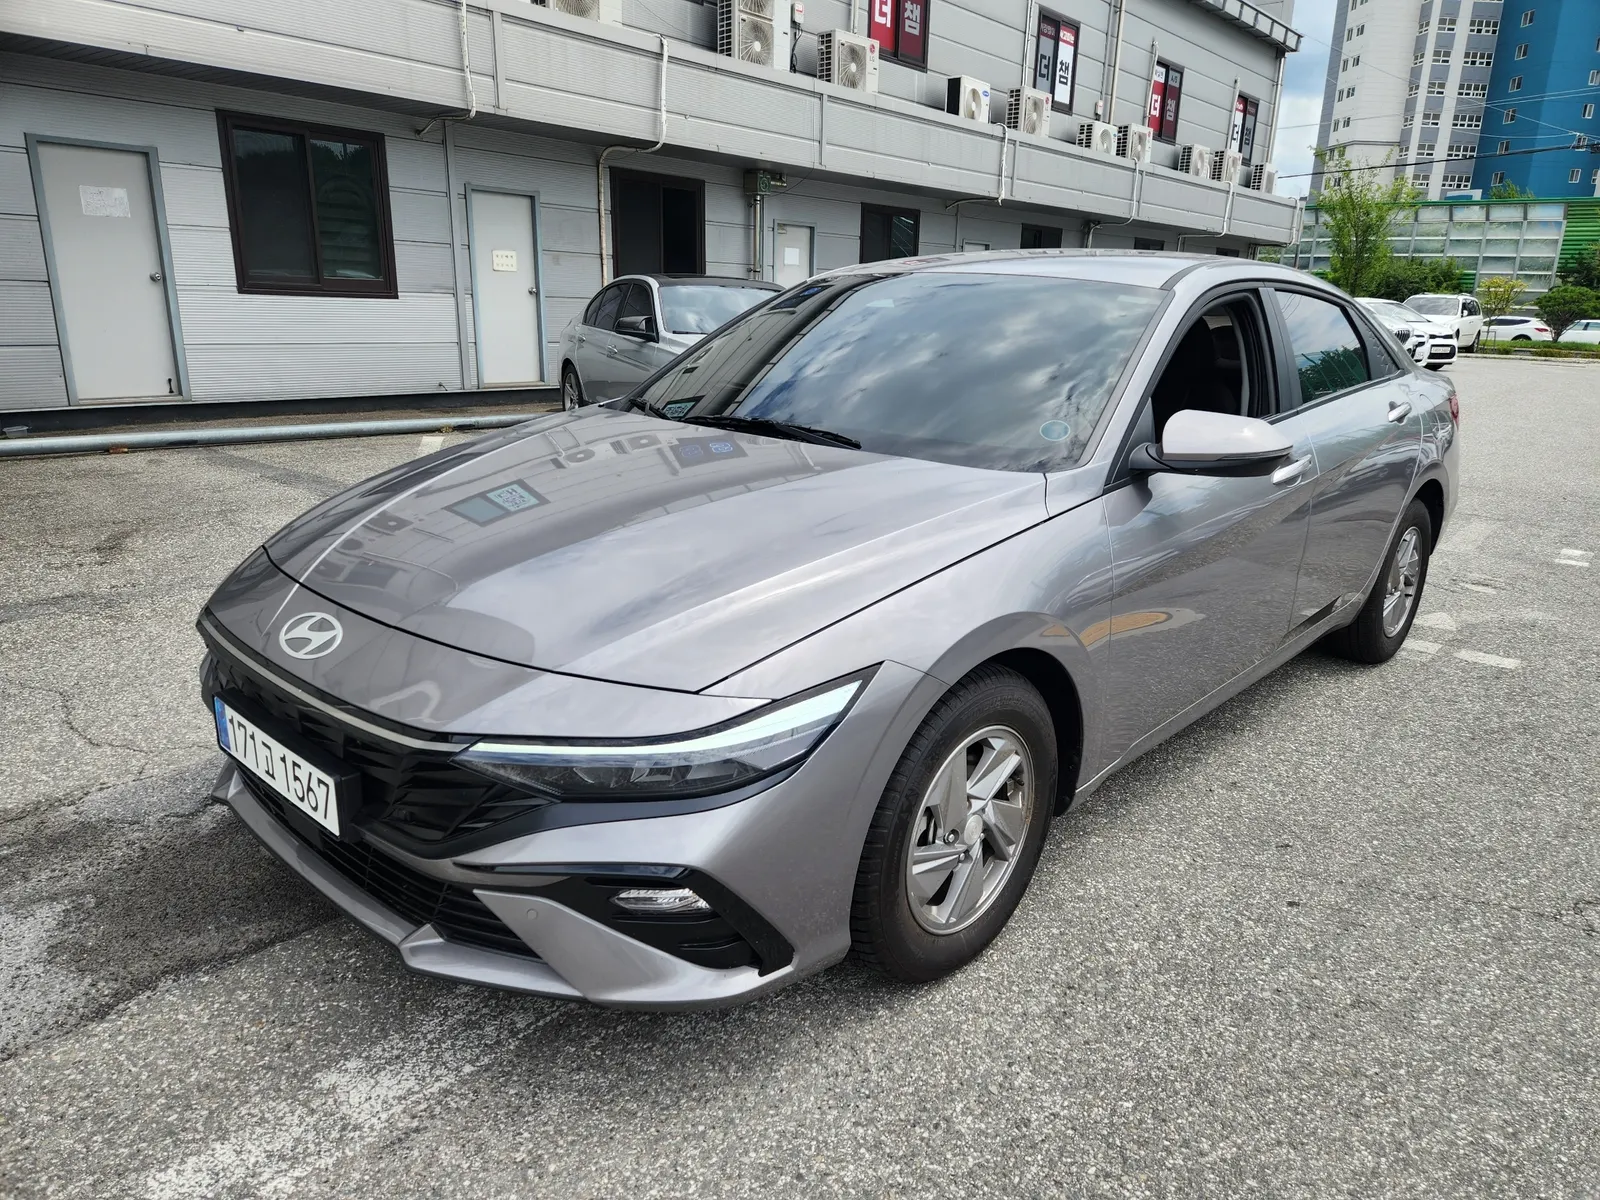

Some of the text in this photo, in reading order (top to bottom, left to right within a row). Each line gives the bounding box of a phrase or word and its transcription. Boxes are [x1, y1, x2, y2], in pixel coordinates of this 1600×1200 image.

[875, 0, 920, 36] 더 챔
[1039, 53, 1070, 86] 더 챔
[1151, 93, 1161, 117] 더
[280, 753, 330, 820] 1567
